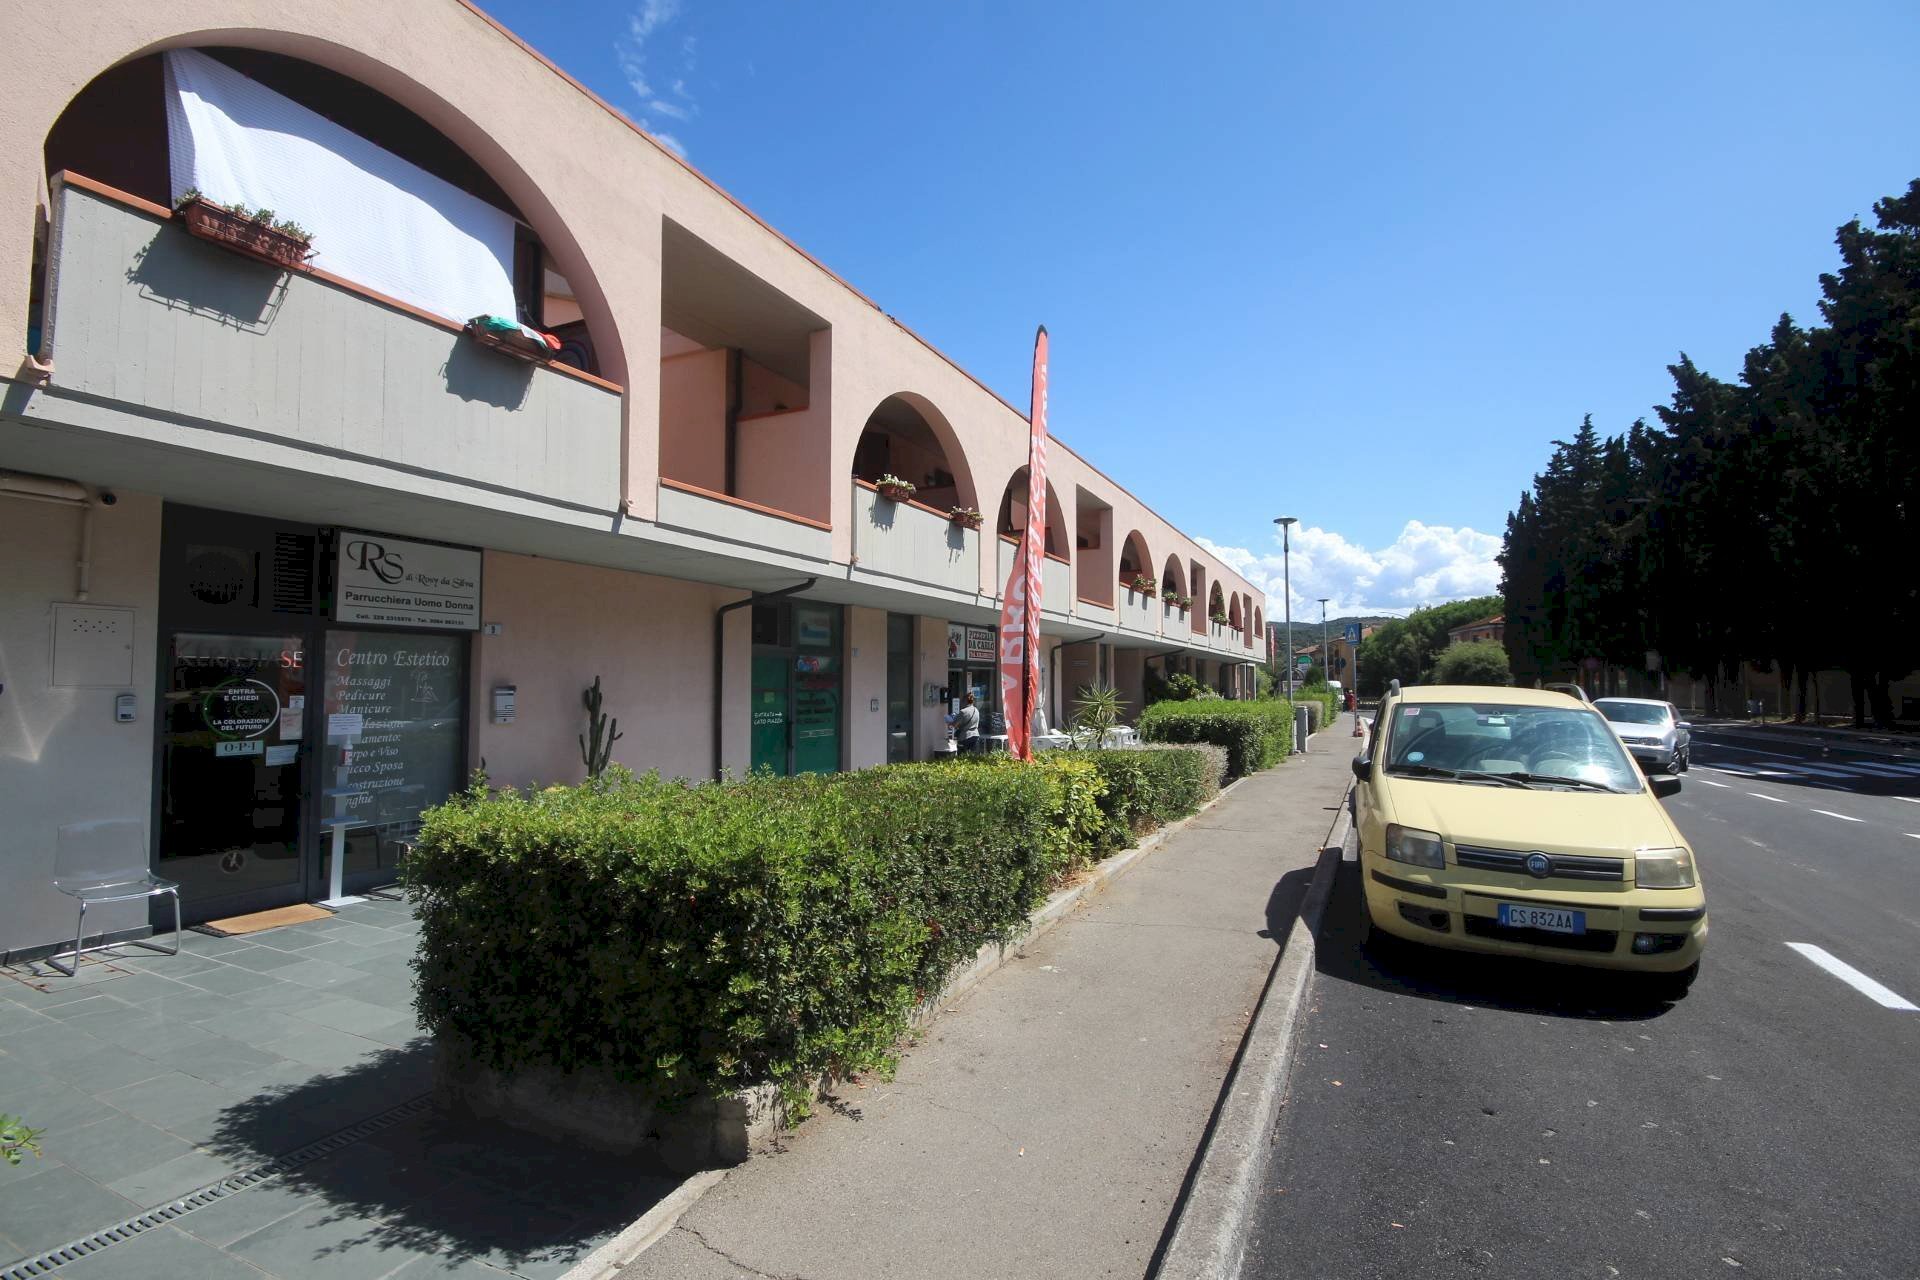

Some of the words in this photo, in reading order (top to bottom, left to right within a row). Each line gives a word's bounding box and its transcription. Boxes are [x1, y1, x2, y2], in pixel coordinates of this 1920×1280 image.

[346, 540, 404, 584] RS
[440, 576, 450, 585] da
[345, 591, 412, 606] Parrucchiera
[414, 597, 442, 608] Uomo
[445, 600, 474, 610] Donna
[337, 648, 388, 667] Centro
[393, 650, 450, 666] Estetico
[336, 675, 392, 689] Massaggi
[336, 689, 386, 701] Pedicure
[337, 703, 392, 714] Manicure
[361, 733, 401, 744] amento:
[377, 746, 399, 757] Viso
[372, 761, 404, 774] Sposa
[346, 794, 374, 808] nghie
[1531, 860, 1546, 869] FIAT
[1510, 908, 1526, 923] CS
[1530, 911, 1572, 929] 832AA
